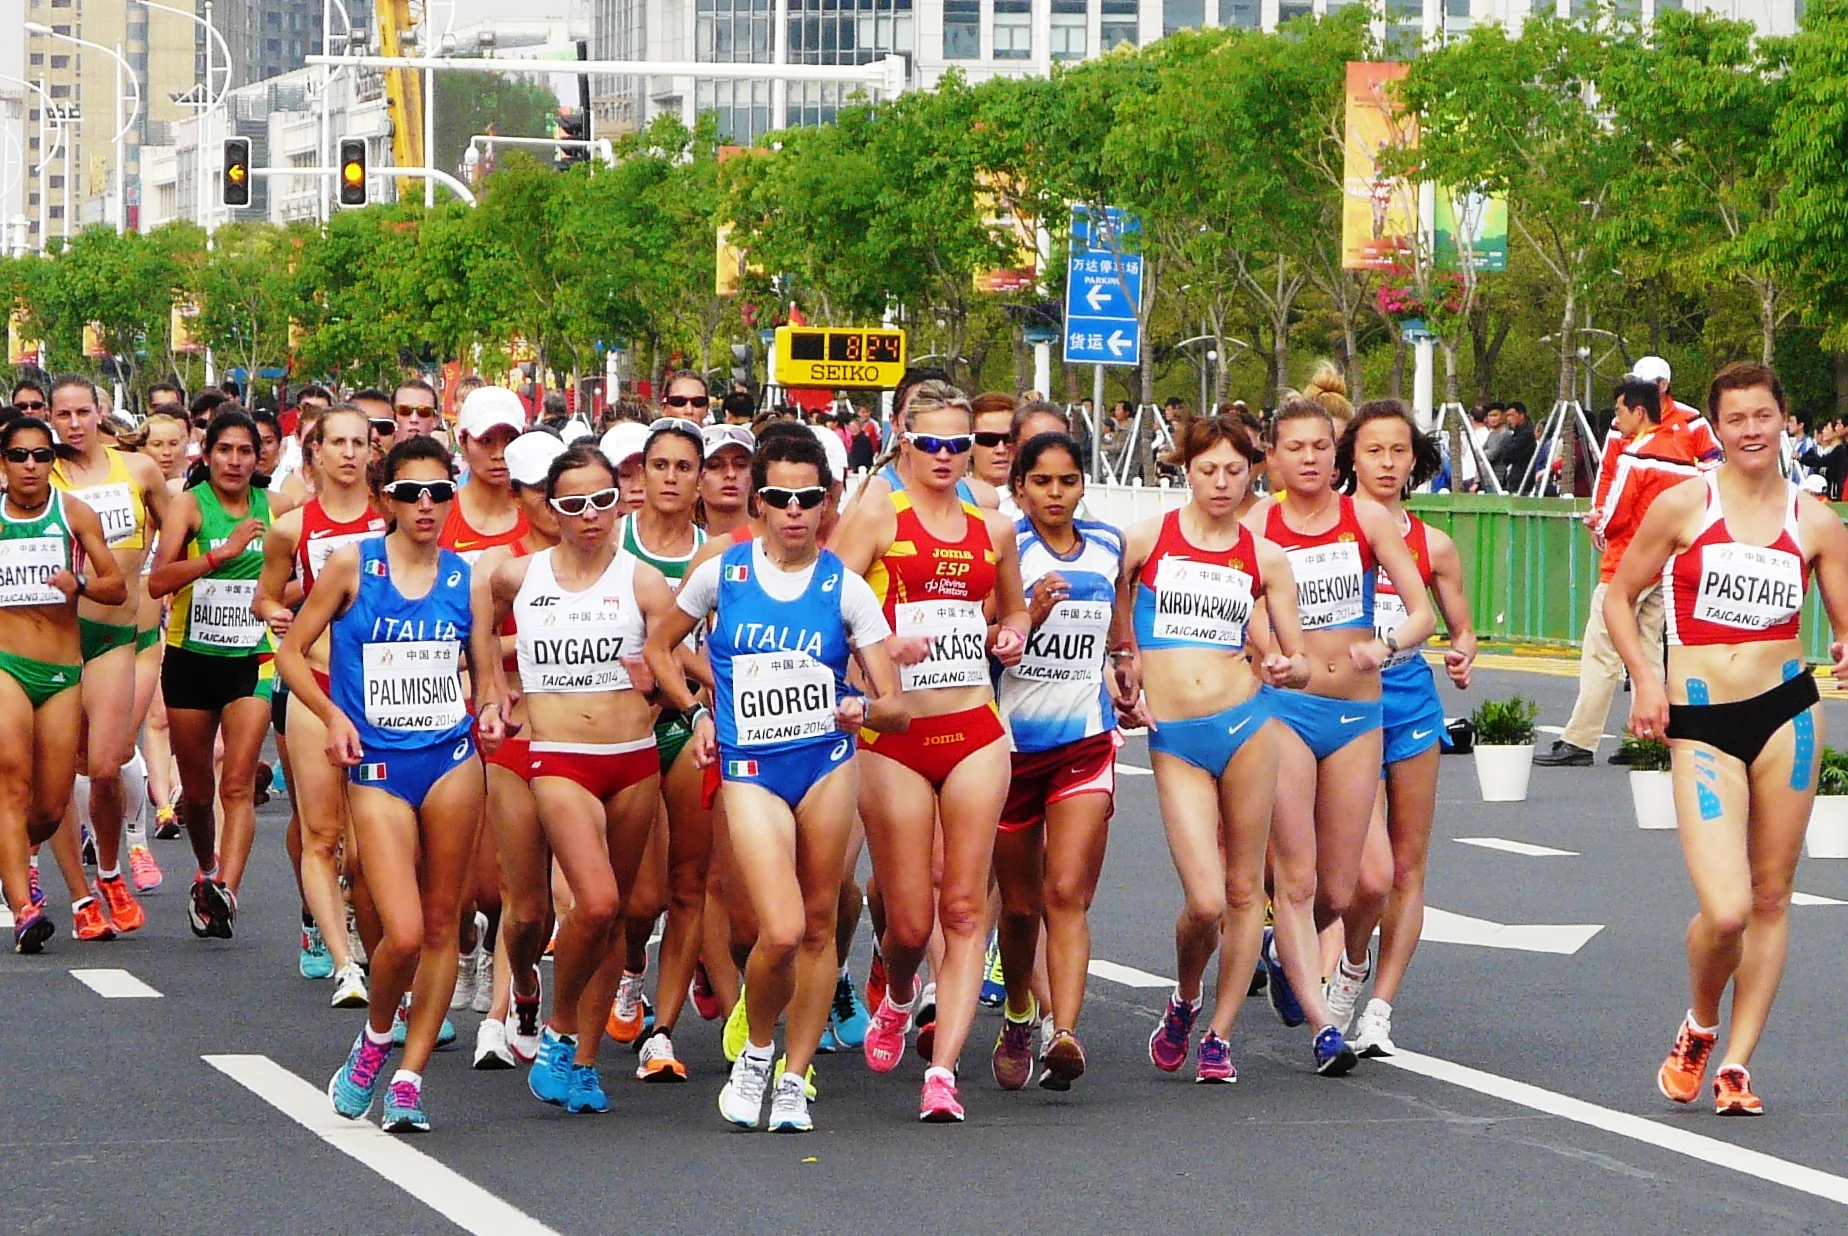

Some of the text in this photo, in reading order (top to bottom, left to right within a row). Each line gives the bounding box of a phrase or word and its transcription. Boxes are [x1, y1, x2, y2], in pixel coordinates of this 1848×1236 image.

[1069, 332, 1104, 351] 货运
[811, 364, 879, 382] SEIKO
[935, 561, 970, 576] ESP
[1296, 573, 1360, 606] MBEKOVA
[1704, 571, 1798, 609] PASTARE
[1159, 590, 1248, 624] KIRDYAPKINA
[1705, 607, 1760, 626] TAICANG
[198, 631, 239, 644] TAICANG
[372, 616, 457, 641] ITALIA
[1165, 624, 1217, 640] TAICANG
[734, 622, 822, 657] ITALIA
[1025, 632, 1095, 660] KAUR
[533, 636, 624, 665] DYGACZ
[541, 670, 618, 687] TAICANG 2014
[912, 671, 965, 687] TAICANG
[1018, 665, 1092, 680] TAICANG 2014
[369, 675, 457, 706] PALMISANO
[740, 683, 829, 718] GIORGI
[377, 713, 457, 727] TAICANG 2014
[746, 721, 827, 741] TAICANG 2014
